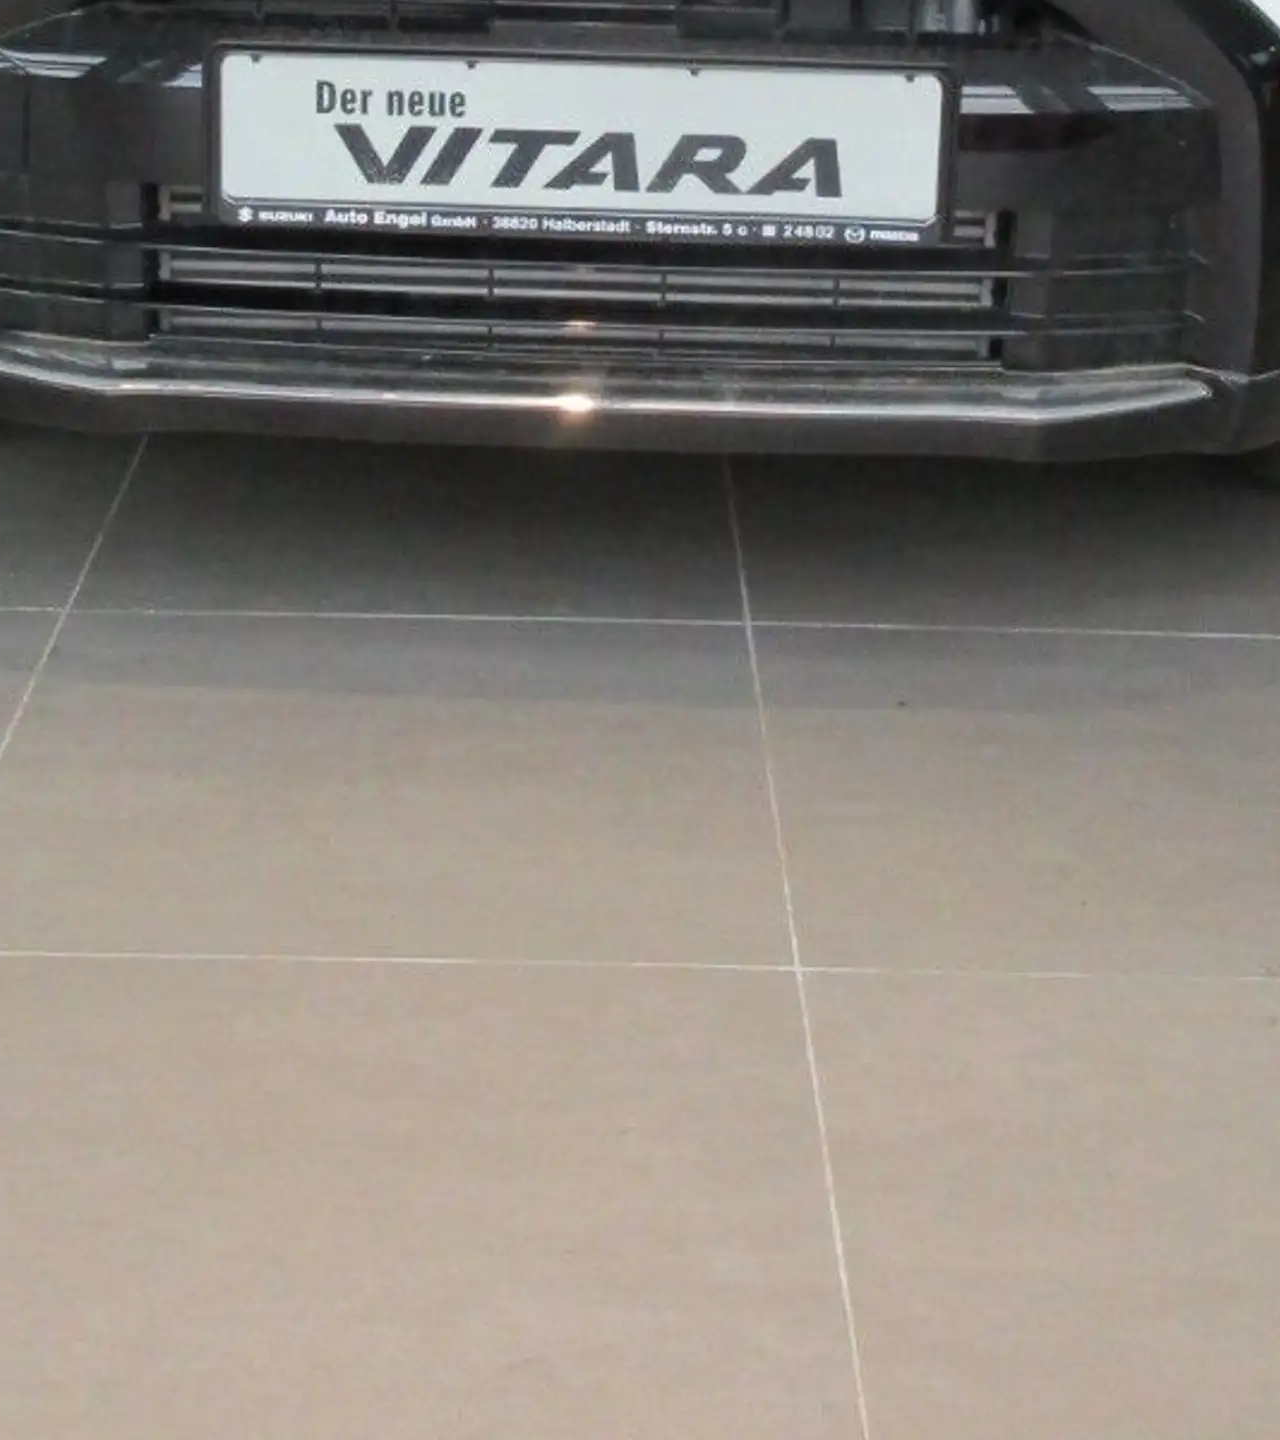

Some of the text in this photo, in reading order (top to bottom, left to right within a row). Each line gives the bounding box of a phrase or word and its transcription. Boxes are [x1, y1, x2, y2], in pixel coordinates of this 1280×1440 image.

[315, 79, 467, 118] Der neue
[333, 122, 843, 199] VITARA
[323, 208, 369, 225] Auto
[373, 210, 427, 229] Engel
[431, 213, 476, 229] GmbH
[542, 216, 631, 234] Halberstadt
